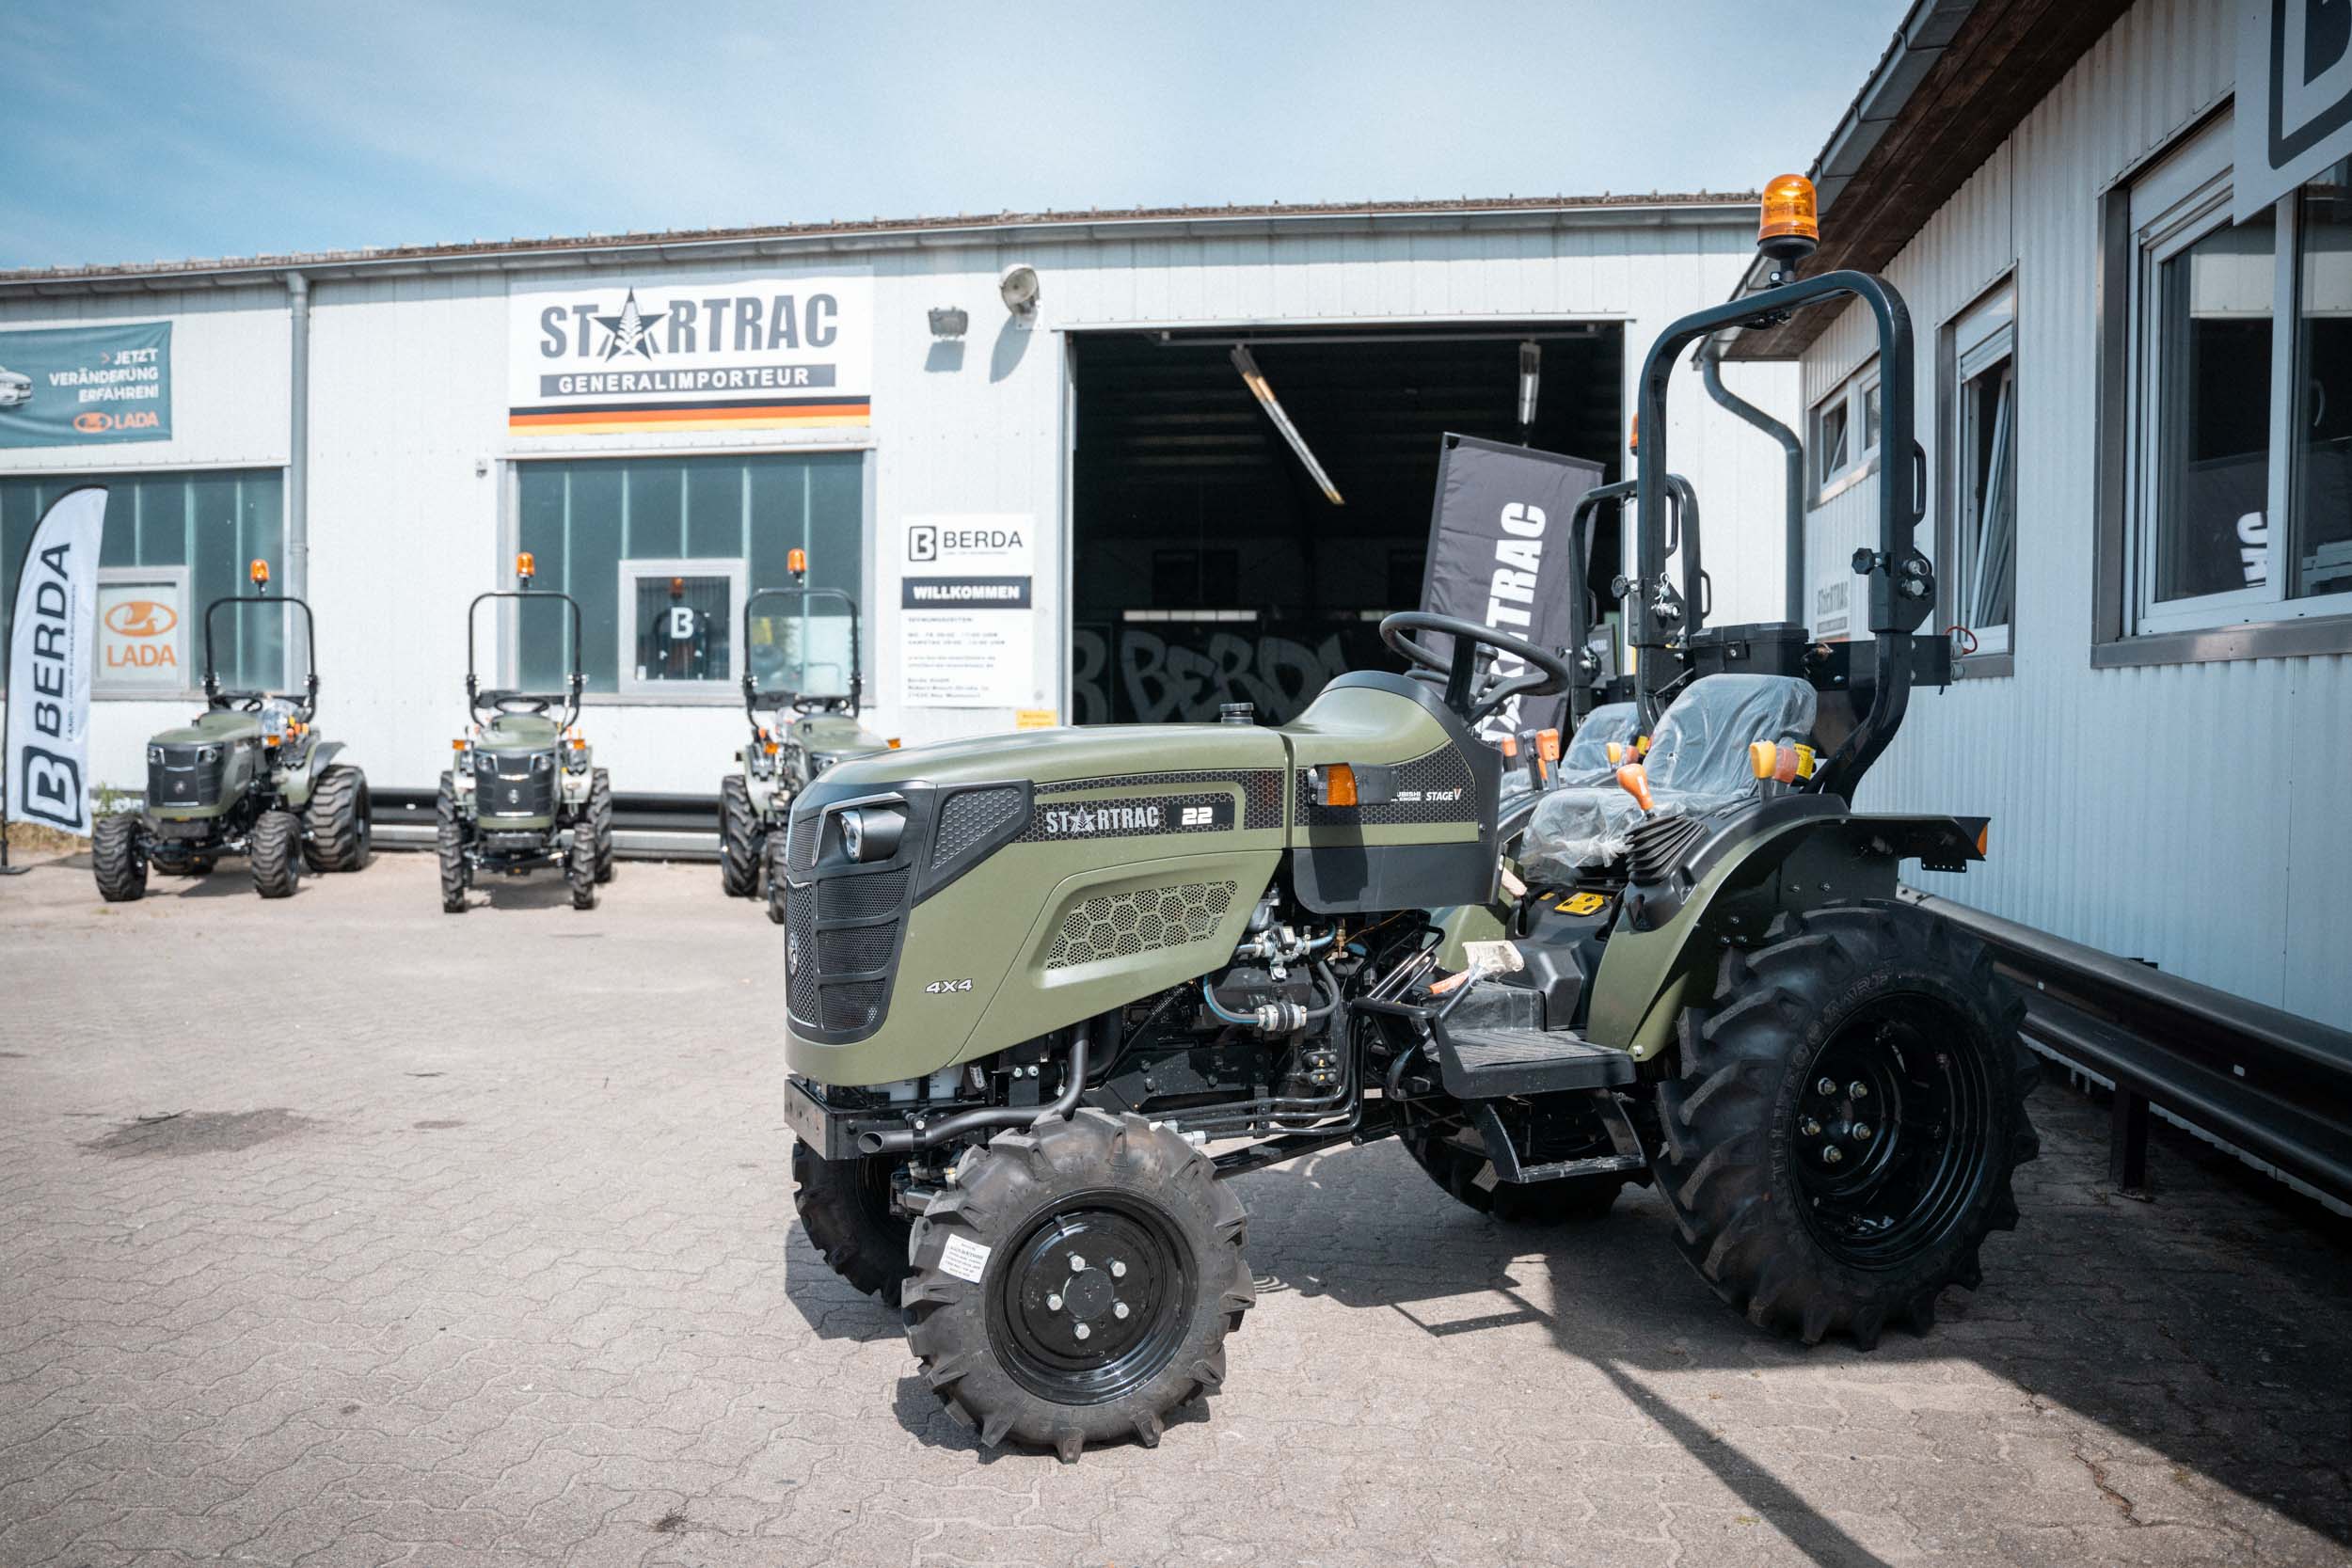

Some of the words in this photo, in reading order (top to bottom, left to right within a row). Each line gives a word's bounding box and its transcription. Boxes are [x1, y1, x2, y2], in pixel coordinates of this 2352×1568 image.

[114, 348, 158, 365] JETZT
[49, 367, 158, 387] VERÄNDERUNG
[559, 368, 809, 393] GENERALIMPORTEUR
[79, 384, 159, 403] ERFAHREN!
[115, 412, 159, 430] LADA
[944, 531, 1024, 548] BERDA
[913, 585, 1020, 600] WILLKOMMEN
[34, 543, 71, 738] BERDA
[107, 644, 177, 668] LADA
[1182, 807, 1213, 826] 22
